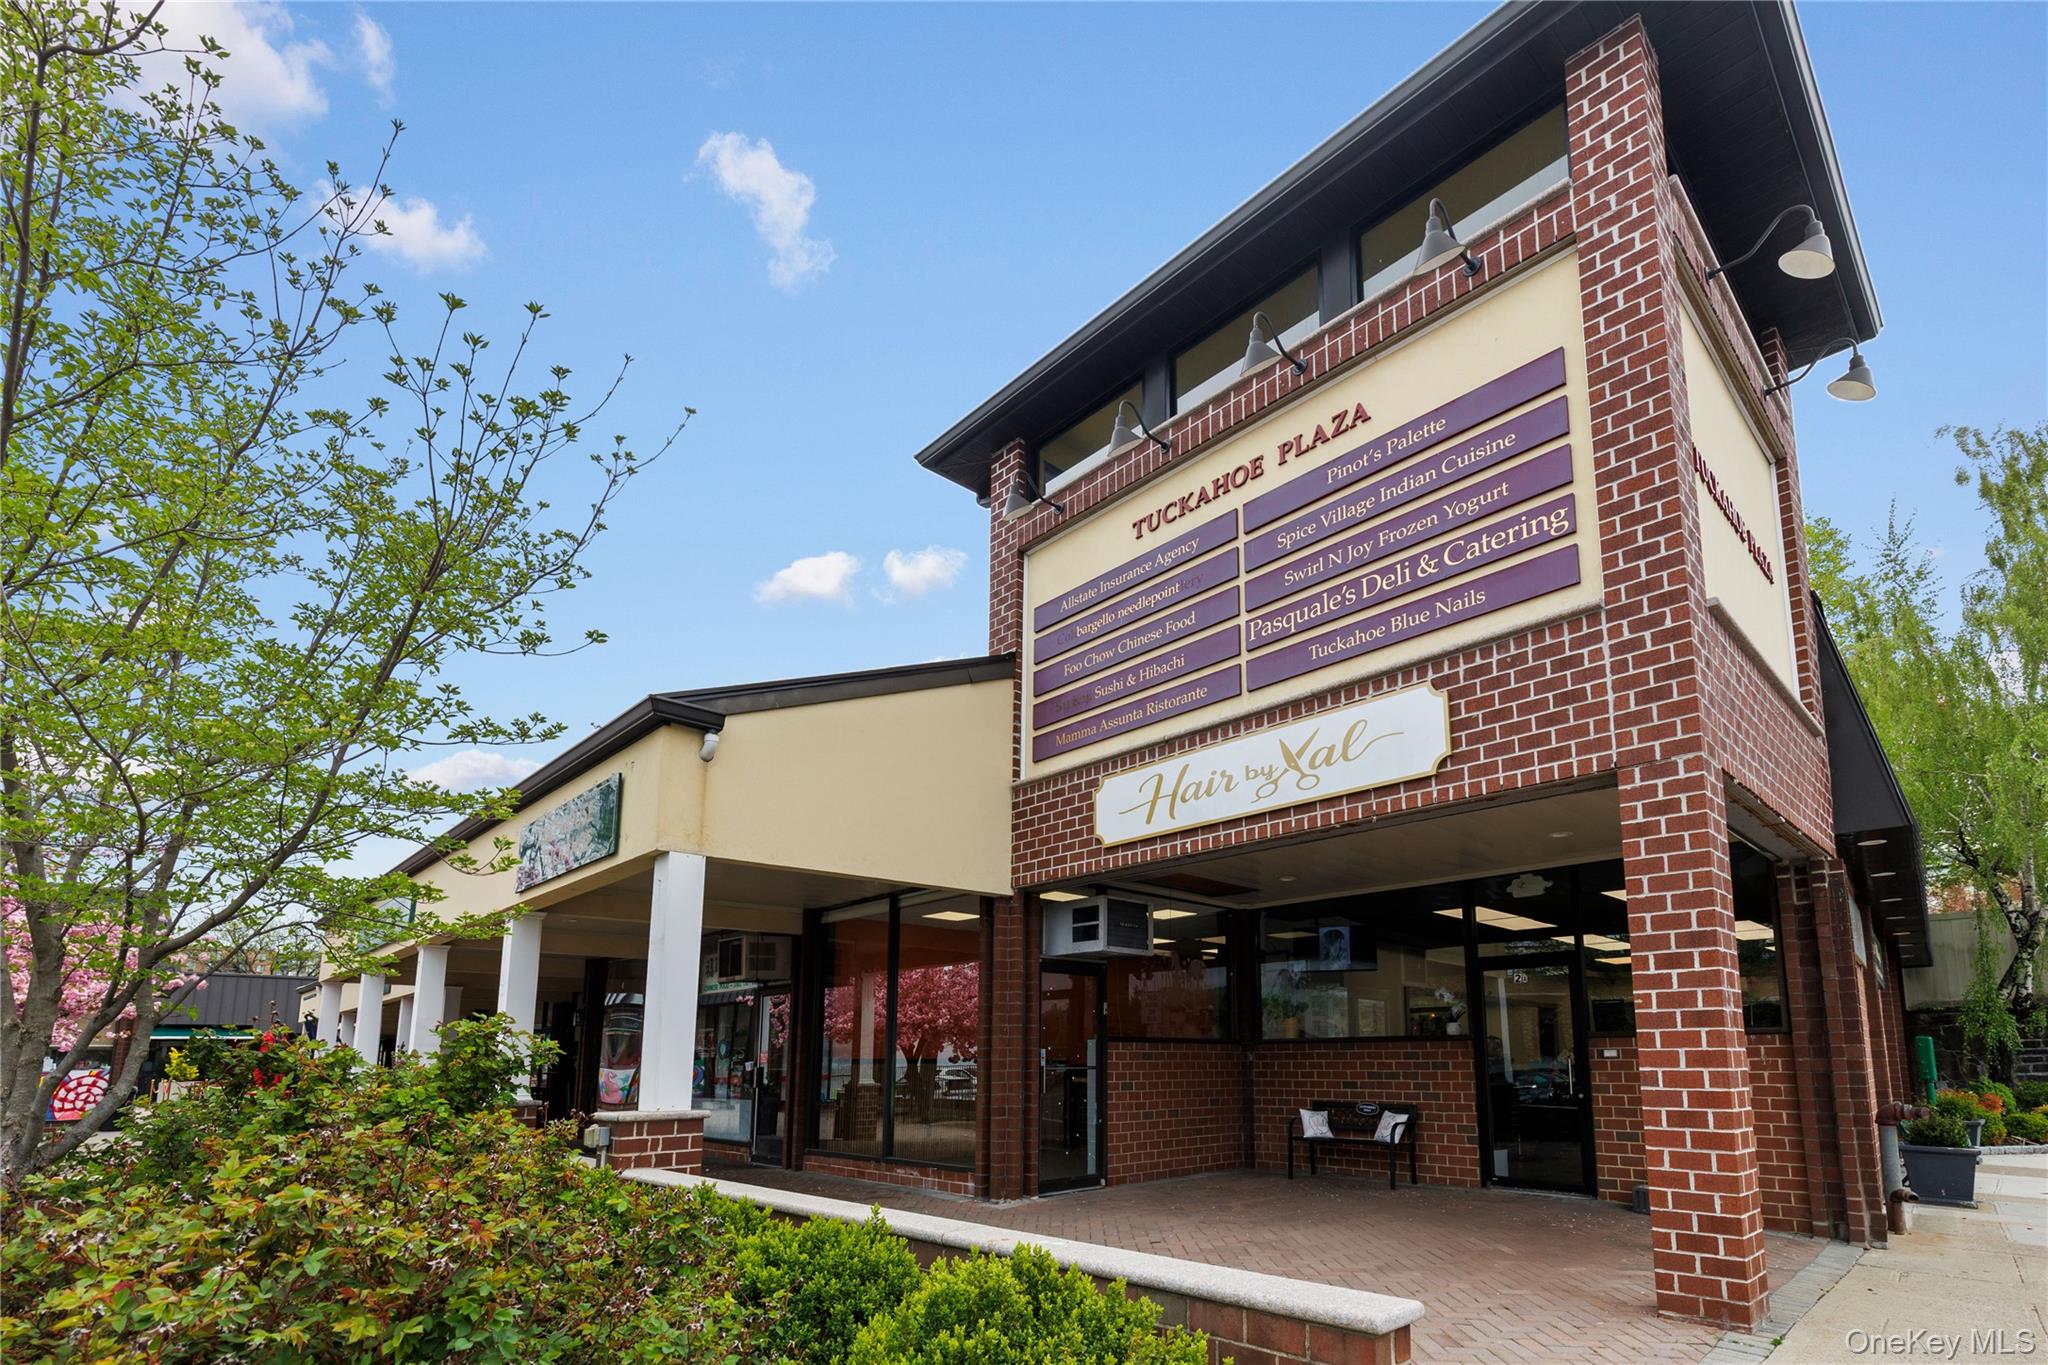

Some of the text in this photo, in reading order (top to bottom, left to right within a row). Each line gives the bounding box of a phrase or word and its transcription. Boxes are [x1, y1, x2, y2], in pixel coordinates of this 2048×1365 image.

[1132, 402, 1372, 540] TUCKAHOE PLAZA
[1326, 418, 1447, 484] Pinot's Palette
[1276, 432, 1517, 549] Spice Village Indian Cuisine
[1283, 481, 1510, 587] Swirl N Joy Frozen Yogurt
[1060, 585, 1098, 613] Allstate
[1100, 560, 1152, 594] Insurance
[1154, 537, 1200, 567] Agency
[1247, 506, 1570, 643] Pasquale's Deli & Catering
[1063, 611, 1197, 677] Foo Chow Chinese Food
[1076, 612, 1116, 639] bargello
[1117, 581, 1181, 621] needlepoint
[1308, 589, 1486, 660] Tuckahoe Blue Nails
[1094, 653, 1185, 700] Sushi & Hibachi
[1055, 686, 1208, 748] Mamma Assunta Ristorante
[1118, 763, 1240, 826] Hair
[1244, 763, 1280, 784] by
